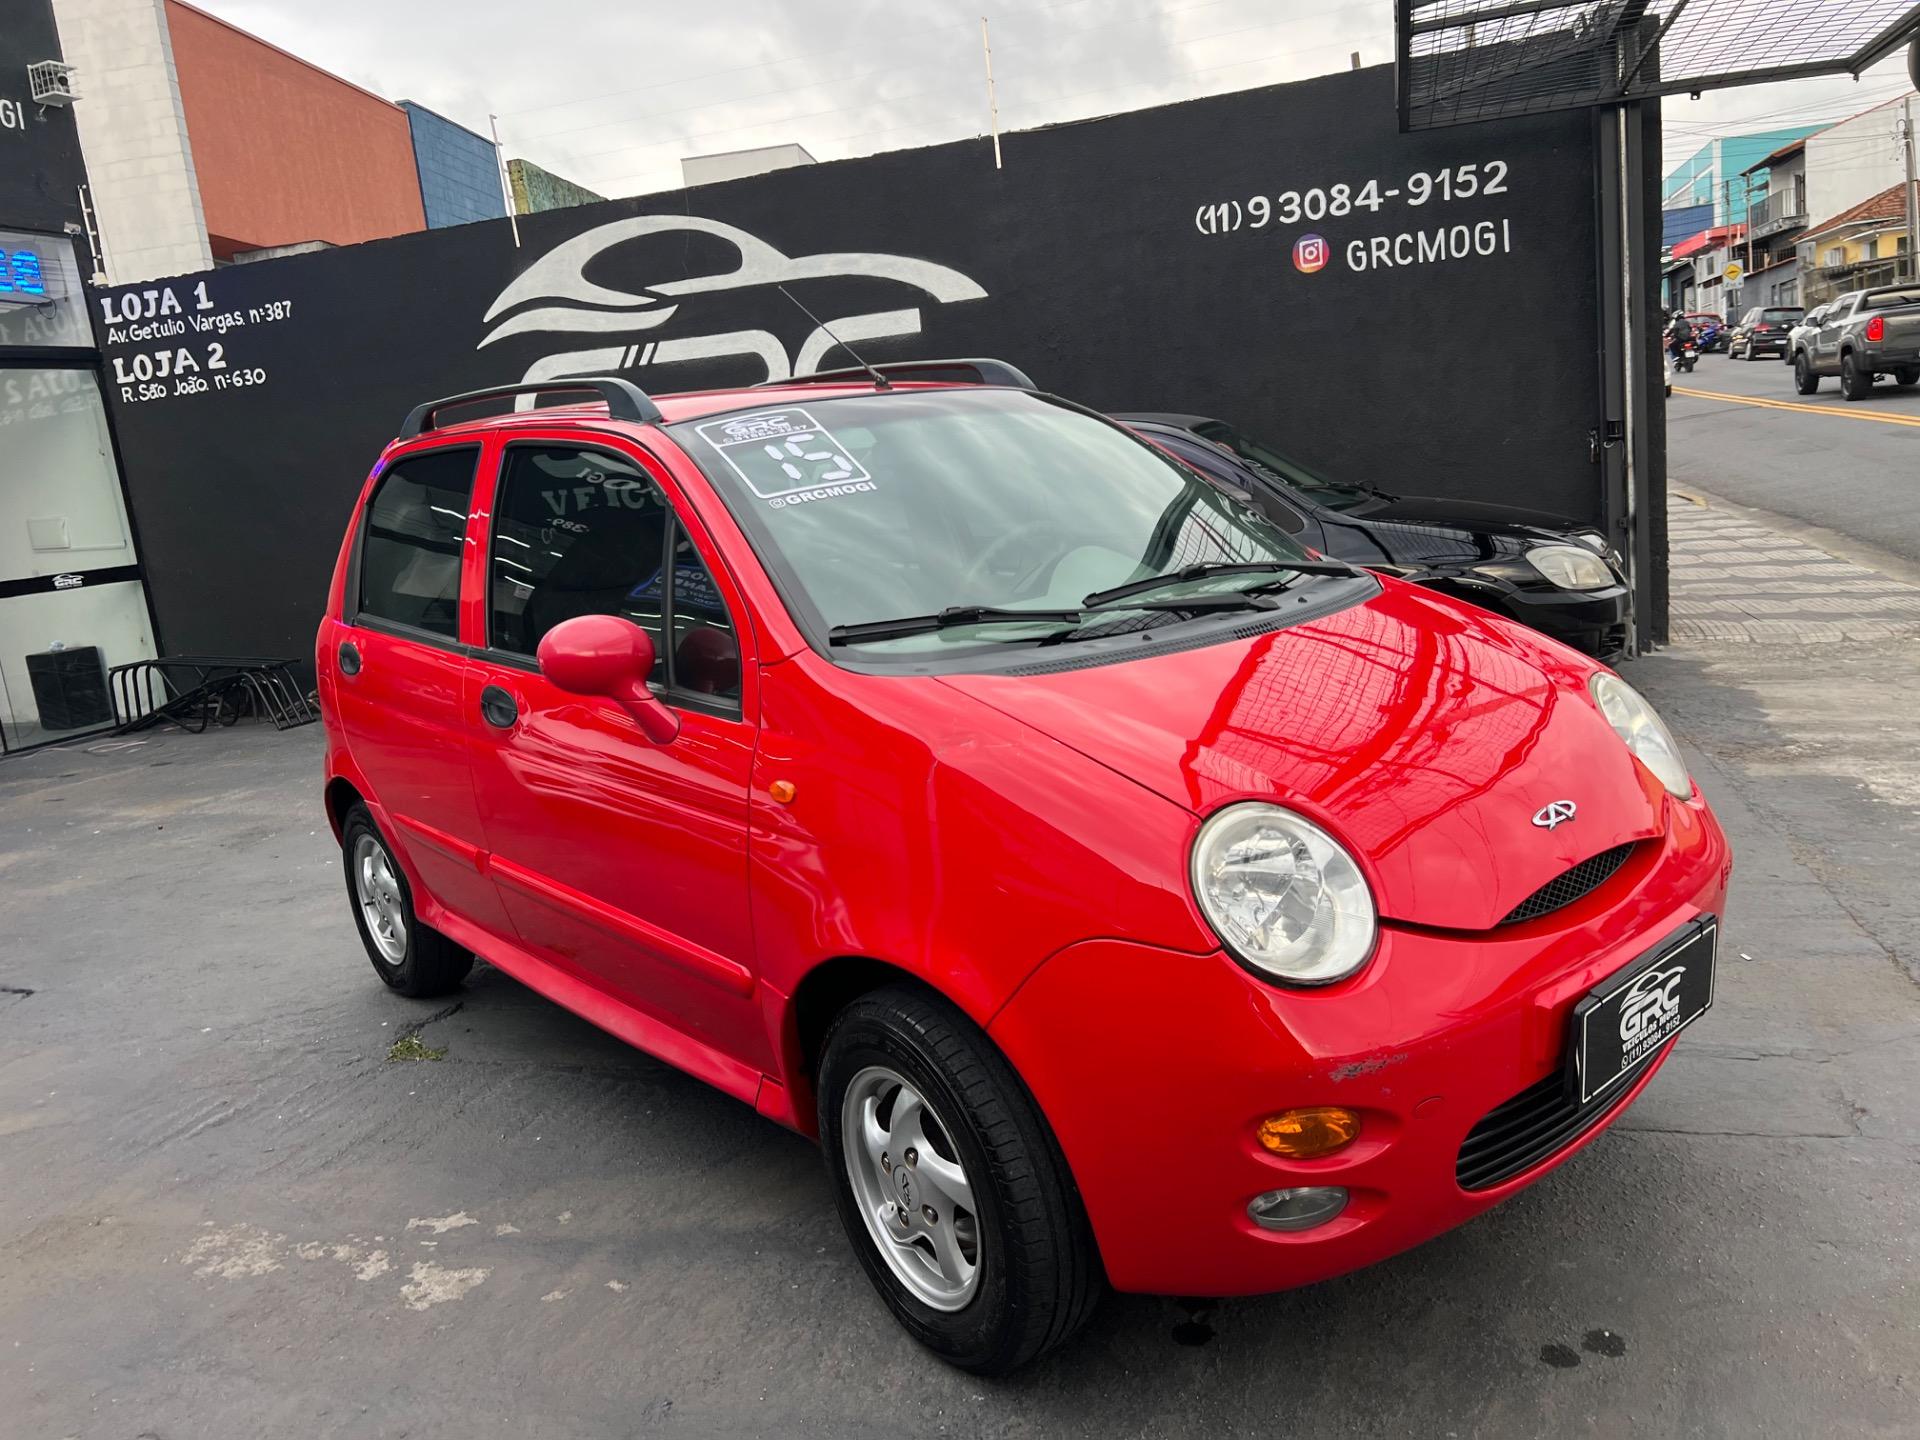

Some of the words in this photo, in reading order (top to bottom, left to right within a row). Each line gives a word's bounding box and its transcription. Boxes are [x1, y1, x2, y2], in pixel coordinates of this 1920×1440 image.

[1346, 218, 1510, 272] GRCMOGI
[101, 287, 182, 324] LOJA
[193, 281, 214, 310] 1
[112, 347, 200, 384] LOJA
[207, 342, 227, 370] 2
[764, 433, 853, 481] 15
[769, 481, 877, 509] @GRCMOGI
[1620, 973, 1681, 1041] GRC
